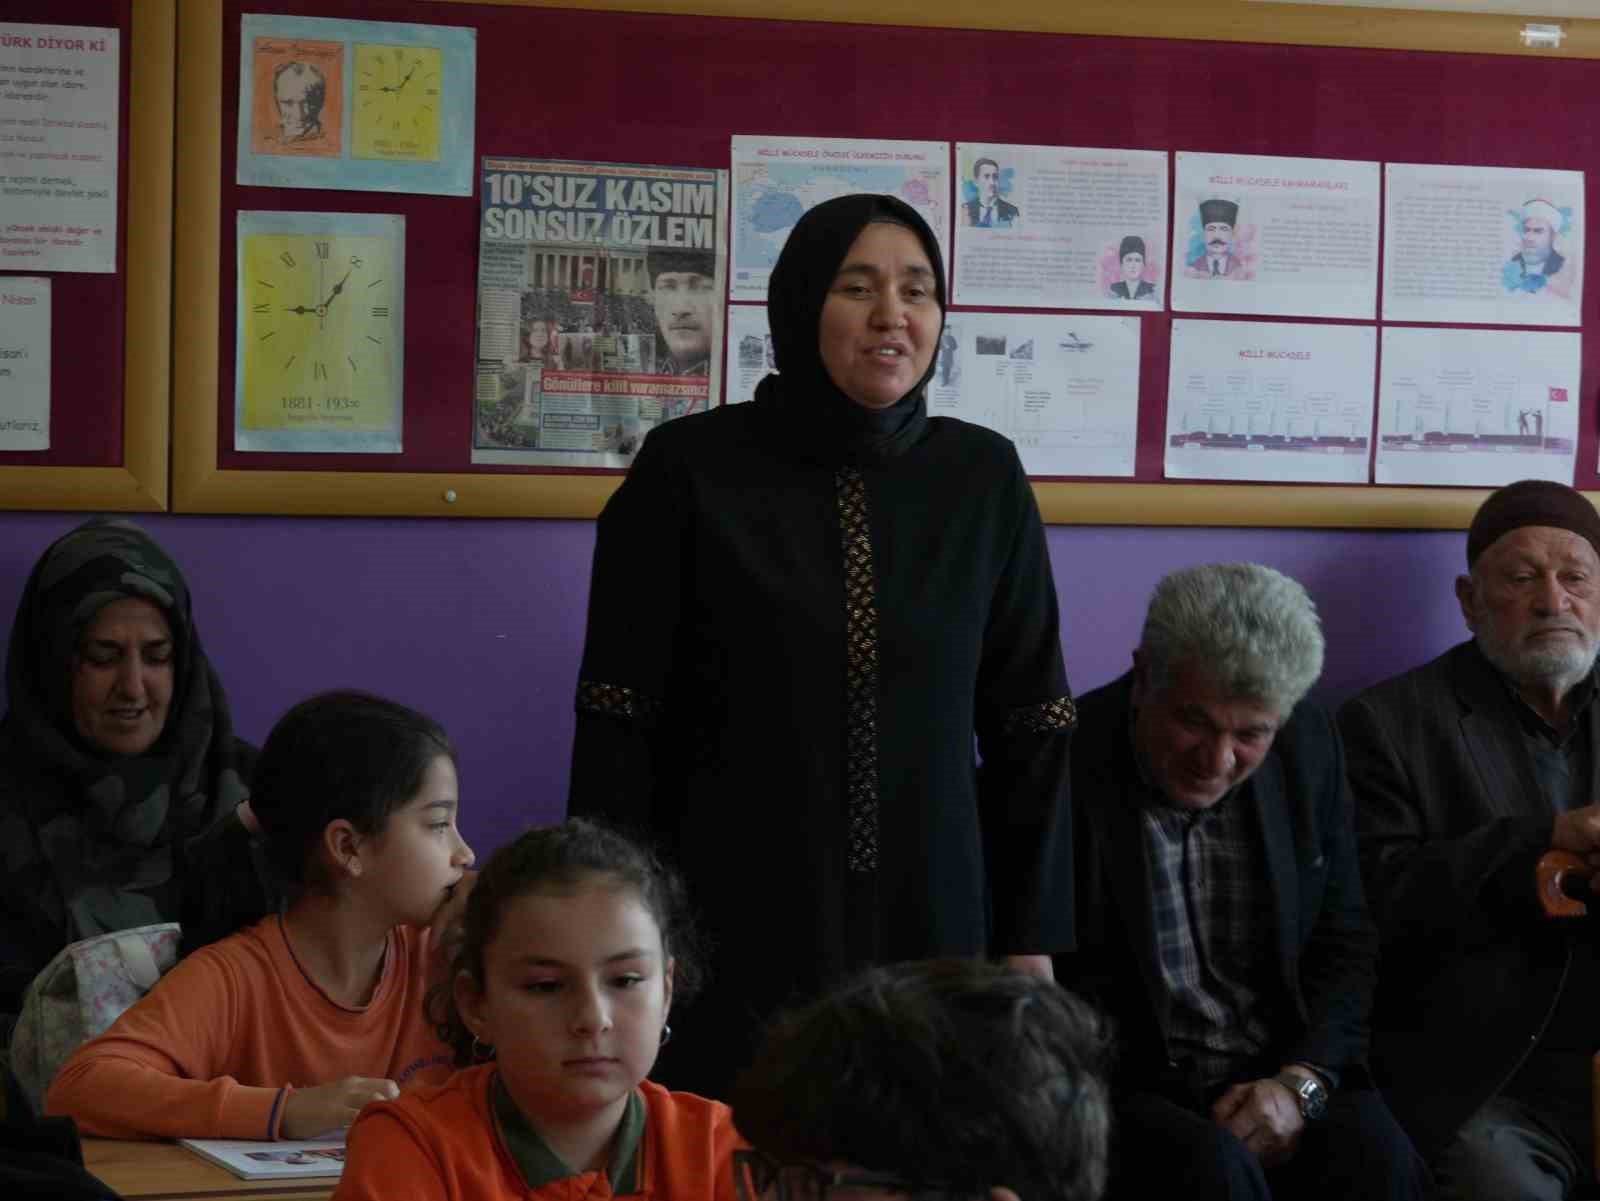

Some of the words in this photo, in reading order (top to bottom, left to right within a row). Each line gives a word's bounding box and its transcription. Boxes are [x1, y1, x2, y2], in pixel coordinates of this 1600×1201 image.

[605, 179, 713, 215] KASIM
[484, 207, 605, 242] SONSUZ
[612, 211, 713, 248] ÖZLEM
[281, 397, 312, 409] 1881
